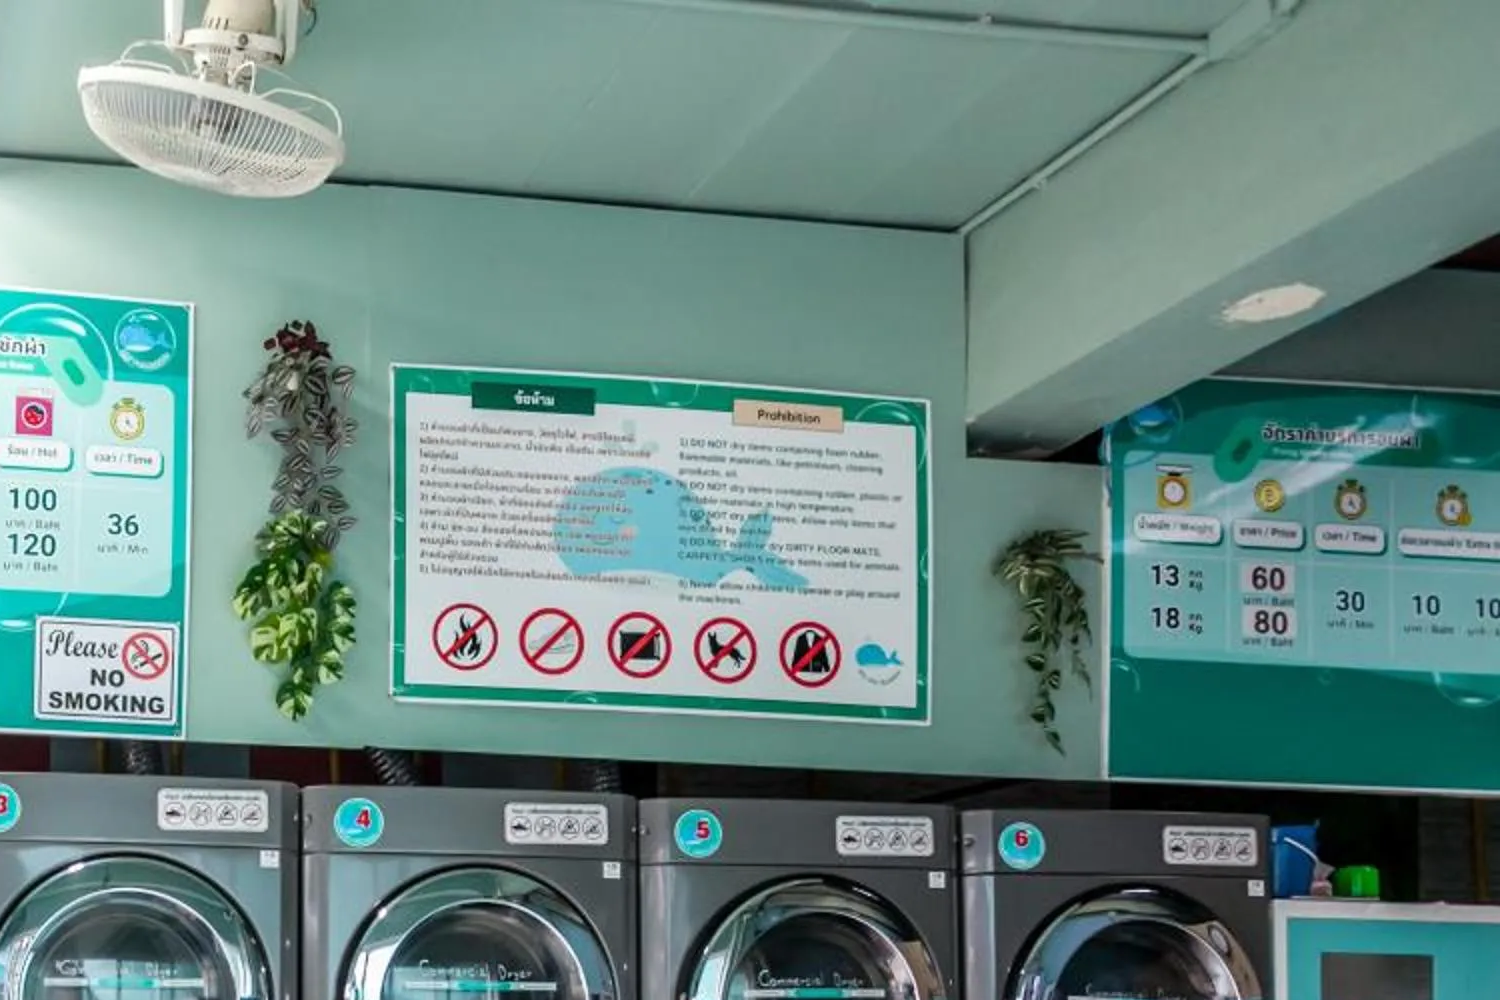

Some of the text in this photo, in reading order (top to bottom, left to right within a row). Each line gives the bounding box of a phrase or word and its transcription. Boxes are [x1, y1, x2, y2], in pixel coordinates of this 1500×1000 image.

[757, 408, 821, 425] Prohibition
[37, 447, 57, 458] Hot
[707, 438, 727, 448] NOT
[126, 454, 153, 465] Time
[8, 488, 57, 511] 100
[107, 513, 139, 536] 36
[1271, 527, 1297, 538] Price
[7, 533, 57, 557] 120
[1352, 532, 1377, 542] Time
[1152, 564, 1180, 587] 13
[1252, 565, 1285, 591] 60
[1189, 580, 1203, 592] Kg
[1335, 590, 1366, 613] 30
[1412, 595, 1441, 616] 10
[1476, 598, 1500, 619] 10
[1152, 607, 1180, 629] 18
[1254, 609, 1288, 635] 80
[1189, 623, 1203, 635] Kg
[45, 629, 119, 659] Please
[90, 668, 125, 687] NO
[48, 691, 165, 714] SMOKING
[356, 808, 371, 828] 4
[695, 820, 710, 839] 5
[1015, 830, 1029, 848] 6
[499, 963, 533, 981] Dryer
